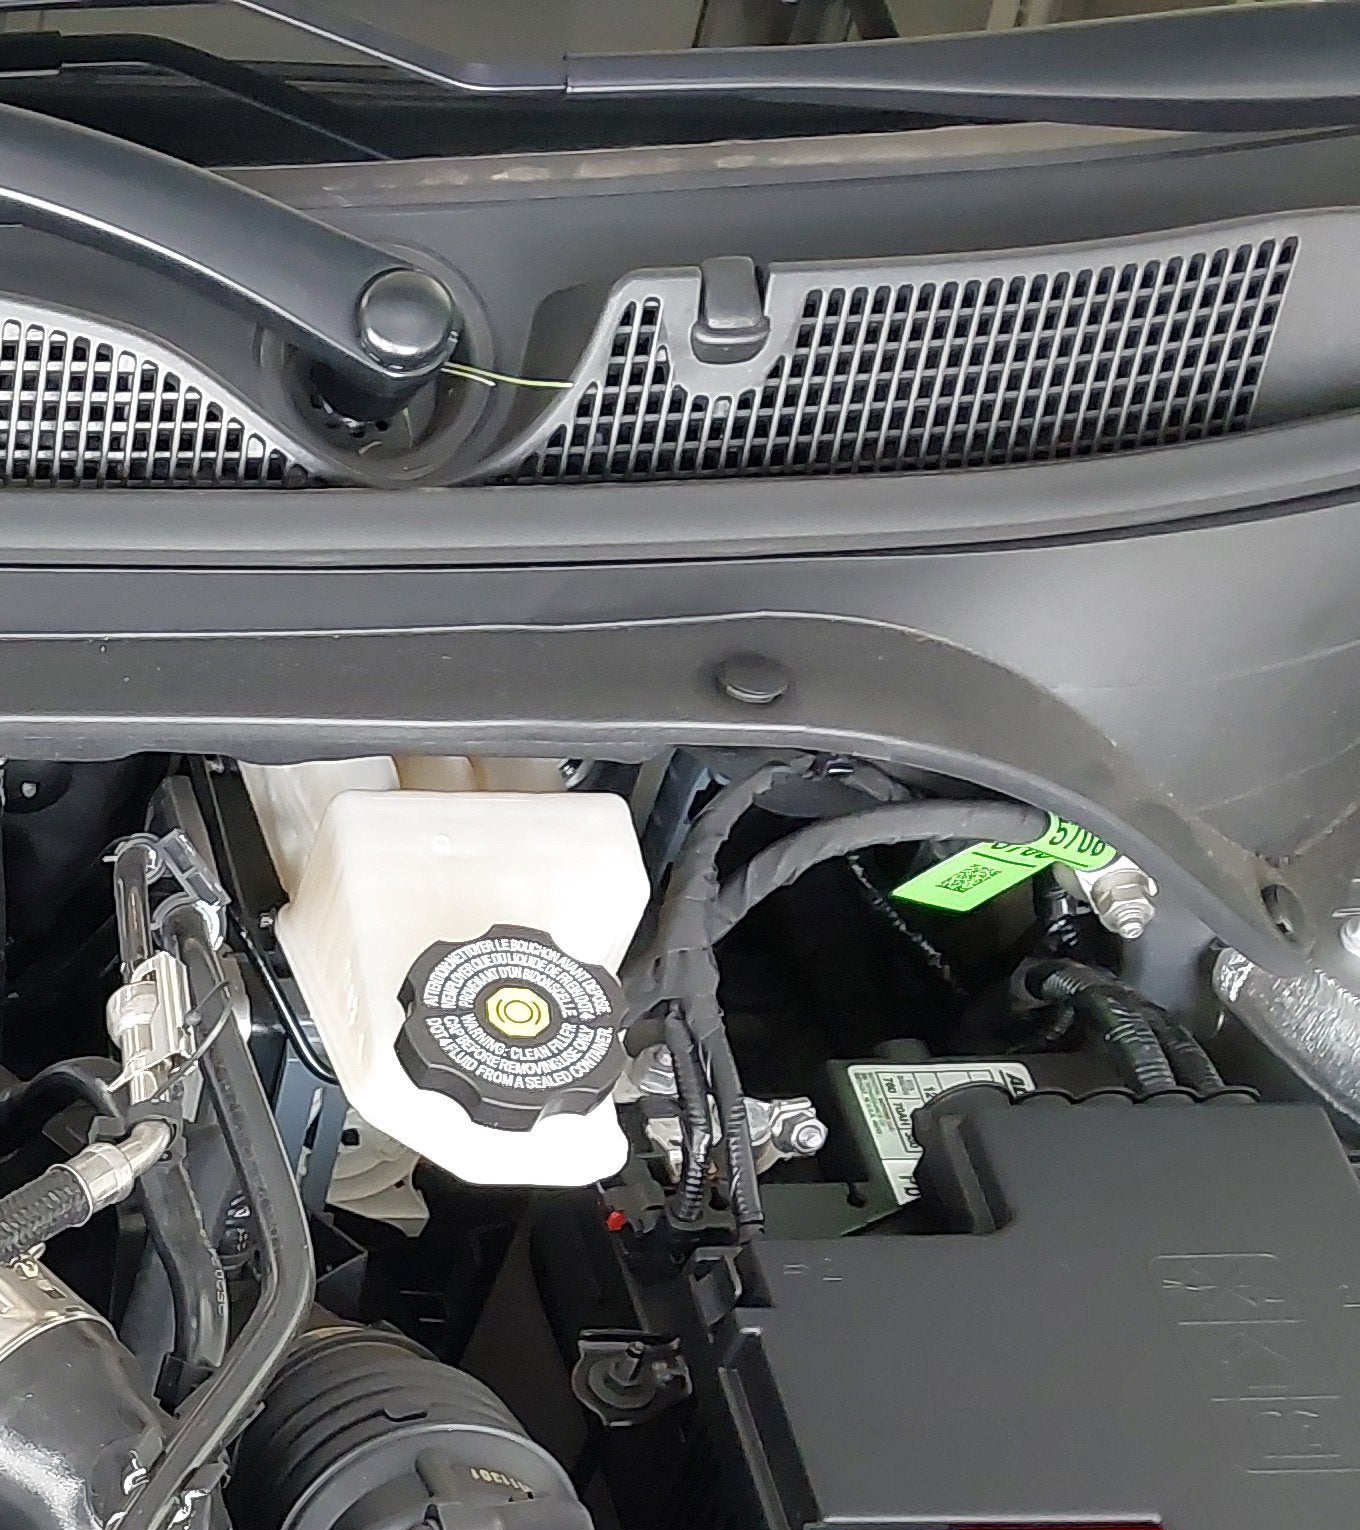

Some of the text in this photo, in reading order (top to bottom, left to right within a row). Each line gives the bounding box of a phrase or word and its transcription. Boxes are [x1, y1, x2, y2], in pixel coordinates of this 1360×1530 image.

[467, 953, 494, 971] QUE
[489, 952, 507, 965] DU
[505, 952, 548, 972] LIQUIDE
[542, 963, 562, 979] DE
[554, 971, 584, 997] FREIN
[571, 994, 592, 1012] DOT
[492, 938, 510, 951] LE
[509, 938, 561, 964] BOUCHON
[555, 955, 590, 983] AVANT
[458, 967, 500, 1008] PROVENANT
[522, 968, 554, 990] BIDON
[425, 1017, 450, 1040] DOT
[442, 1042, 479, 1072] FLUID
[474, 1063, 513, 1087] FROM
[513, 1075, 523, 1088] A
[524, 1069, 576, 1089] SEALED
[442, 1015, 466, 1038] CAP
[454, 1034, 501, 1068] BEFORE
[556, 1046, 584, 1067] USE
[571, 1023, 595, 1052] ONLY
[459, 1013, 577, 1060] WARNING: CLEAN FILLER
